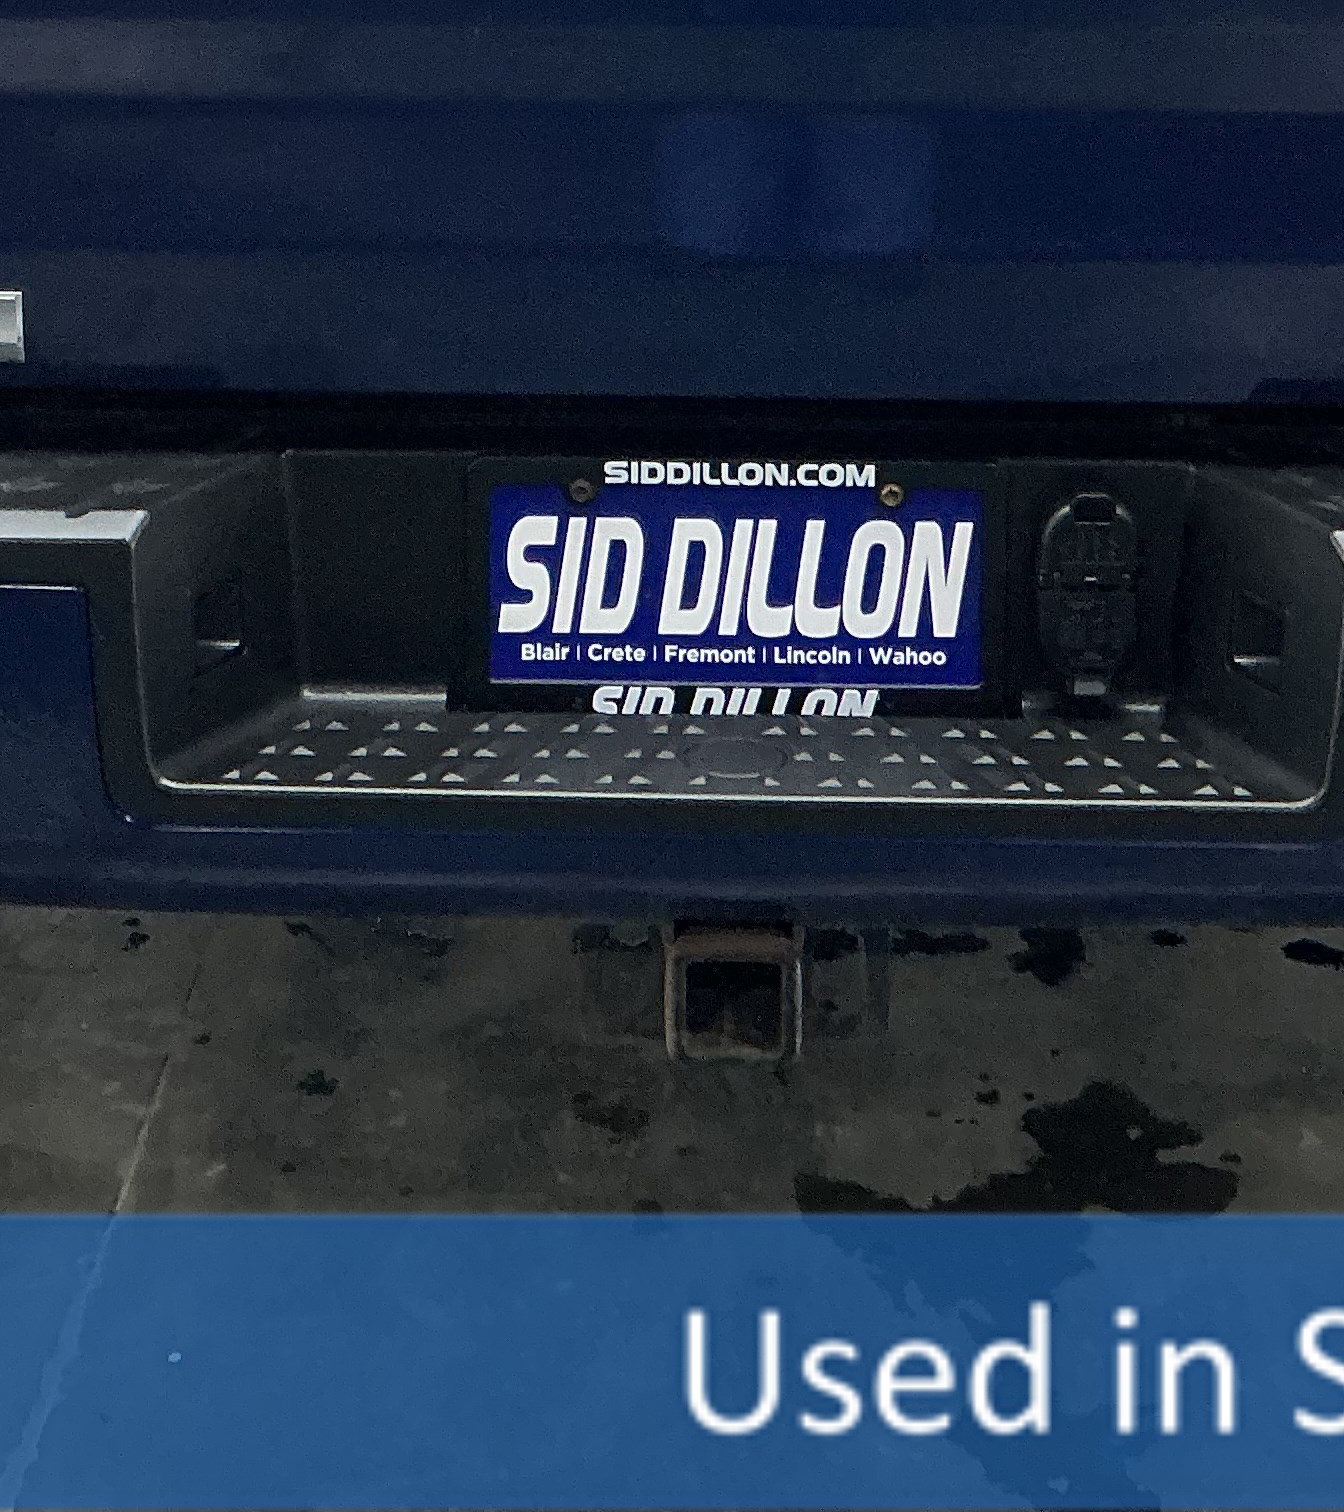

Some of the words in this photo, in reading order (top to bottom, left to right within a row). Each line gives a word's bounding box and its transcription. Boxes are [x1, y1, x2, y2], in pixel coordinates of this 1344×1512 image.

[602, 459, 877, 489] SIDDILLON.COM
[497, 514, 646, 635] SID
[657, 516, 975, 639] DILLON
[520, 642, 571, 662] Blair
[587, 643, 646, 663] Crete
[664, 644, 756, 664] Fremont
[773, 645, 851, 665] Lincoln
[868, 645, 947, 666] Wahoo
